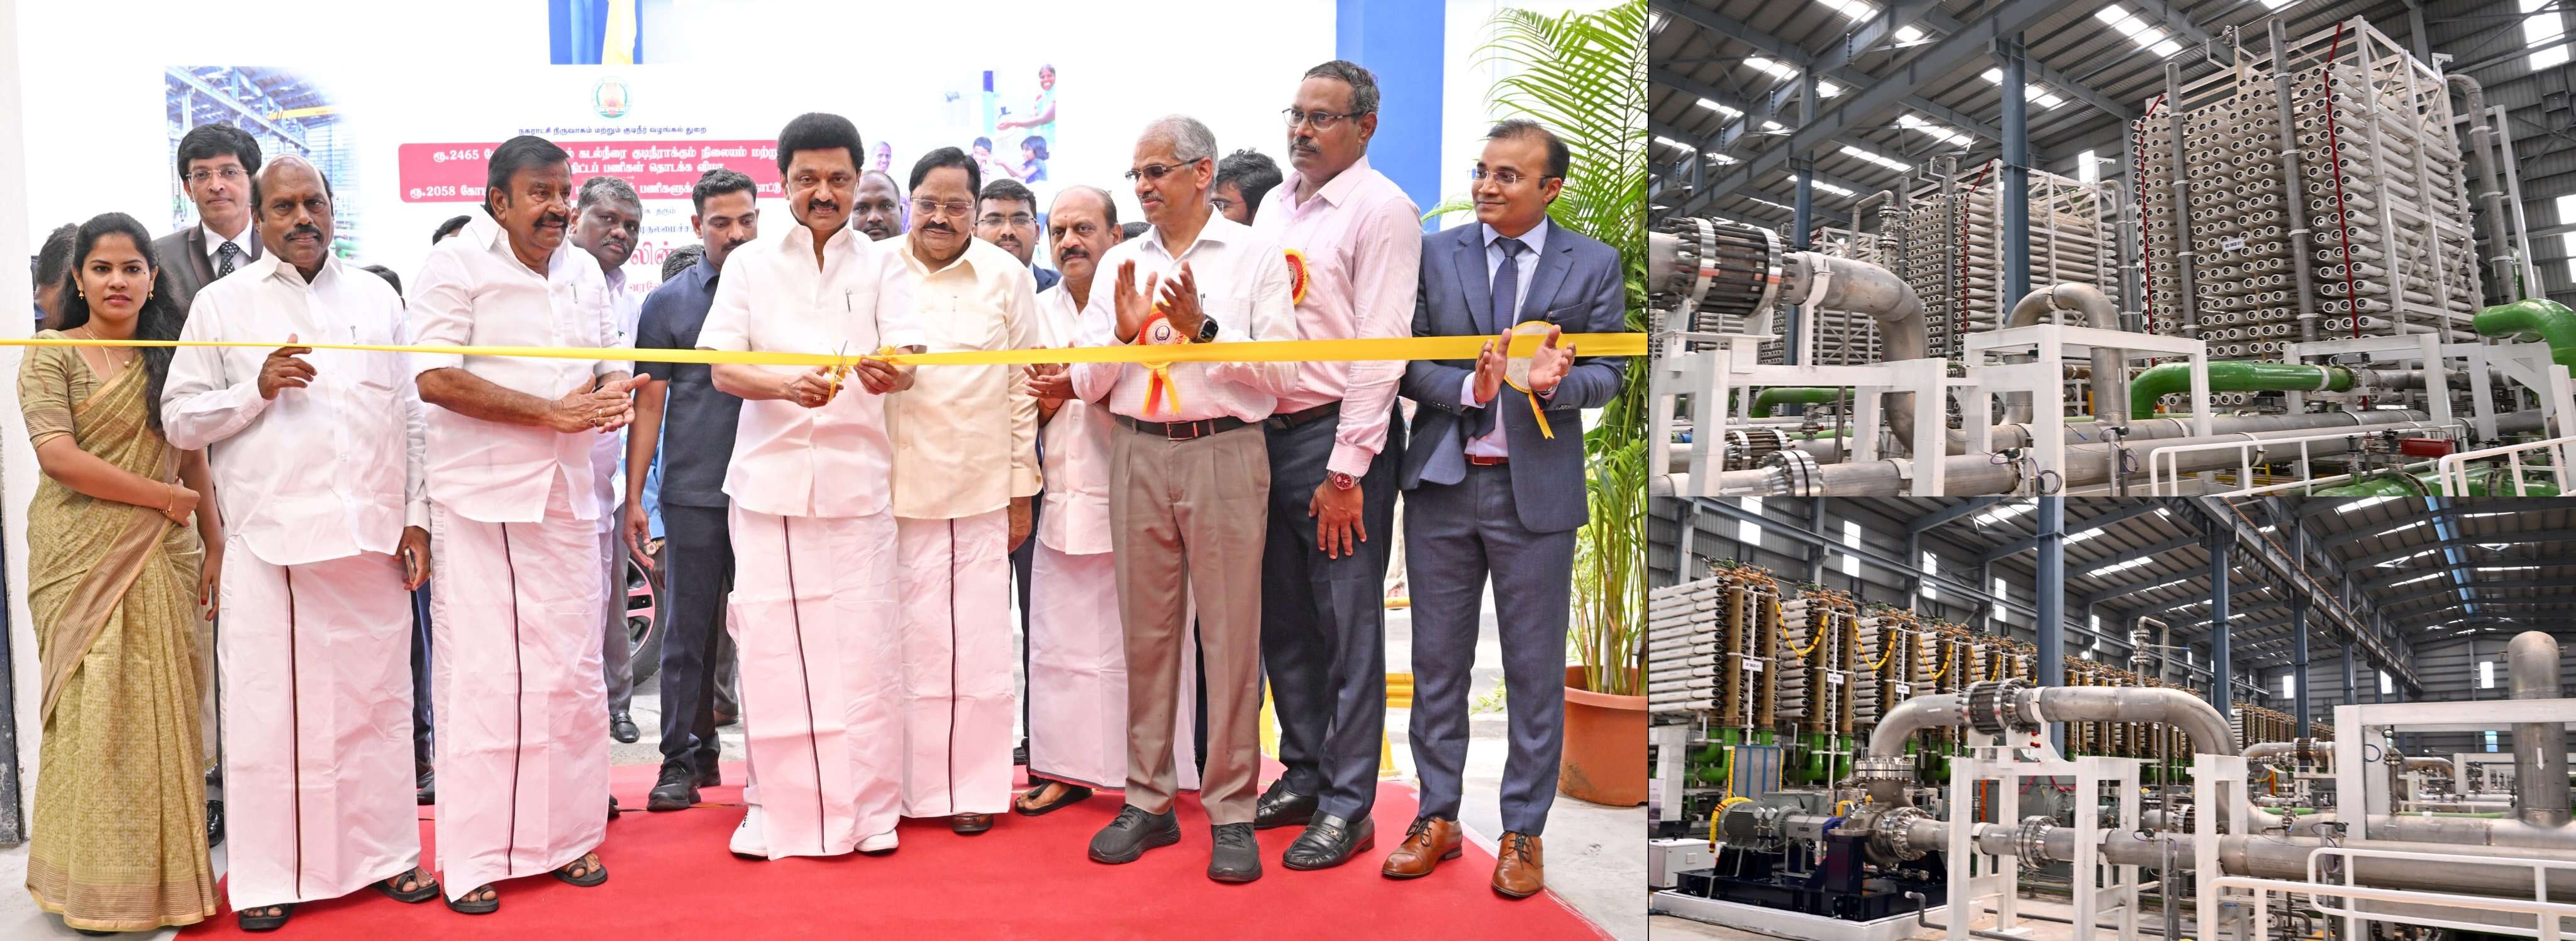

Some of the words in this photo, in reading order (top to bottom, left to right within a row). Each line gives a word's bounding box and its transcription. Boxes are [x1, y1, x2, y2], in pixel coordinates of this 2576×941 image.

[595, 126, 621, 136] மற்றும்
[623, 125, 647, 135] குடிநீர்
[686, 126, 707, 135] துறை
[579, 146, 627, 160] கடல்நீரை
[701, 146, 747, 160] நிலையம்
[604, 161, 645, 173] பணிகள்
